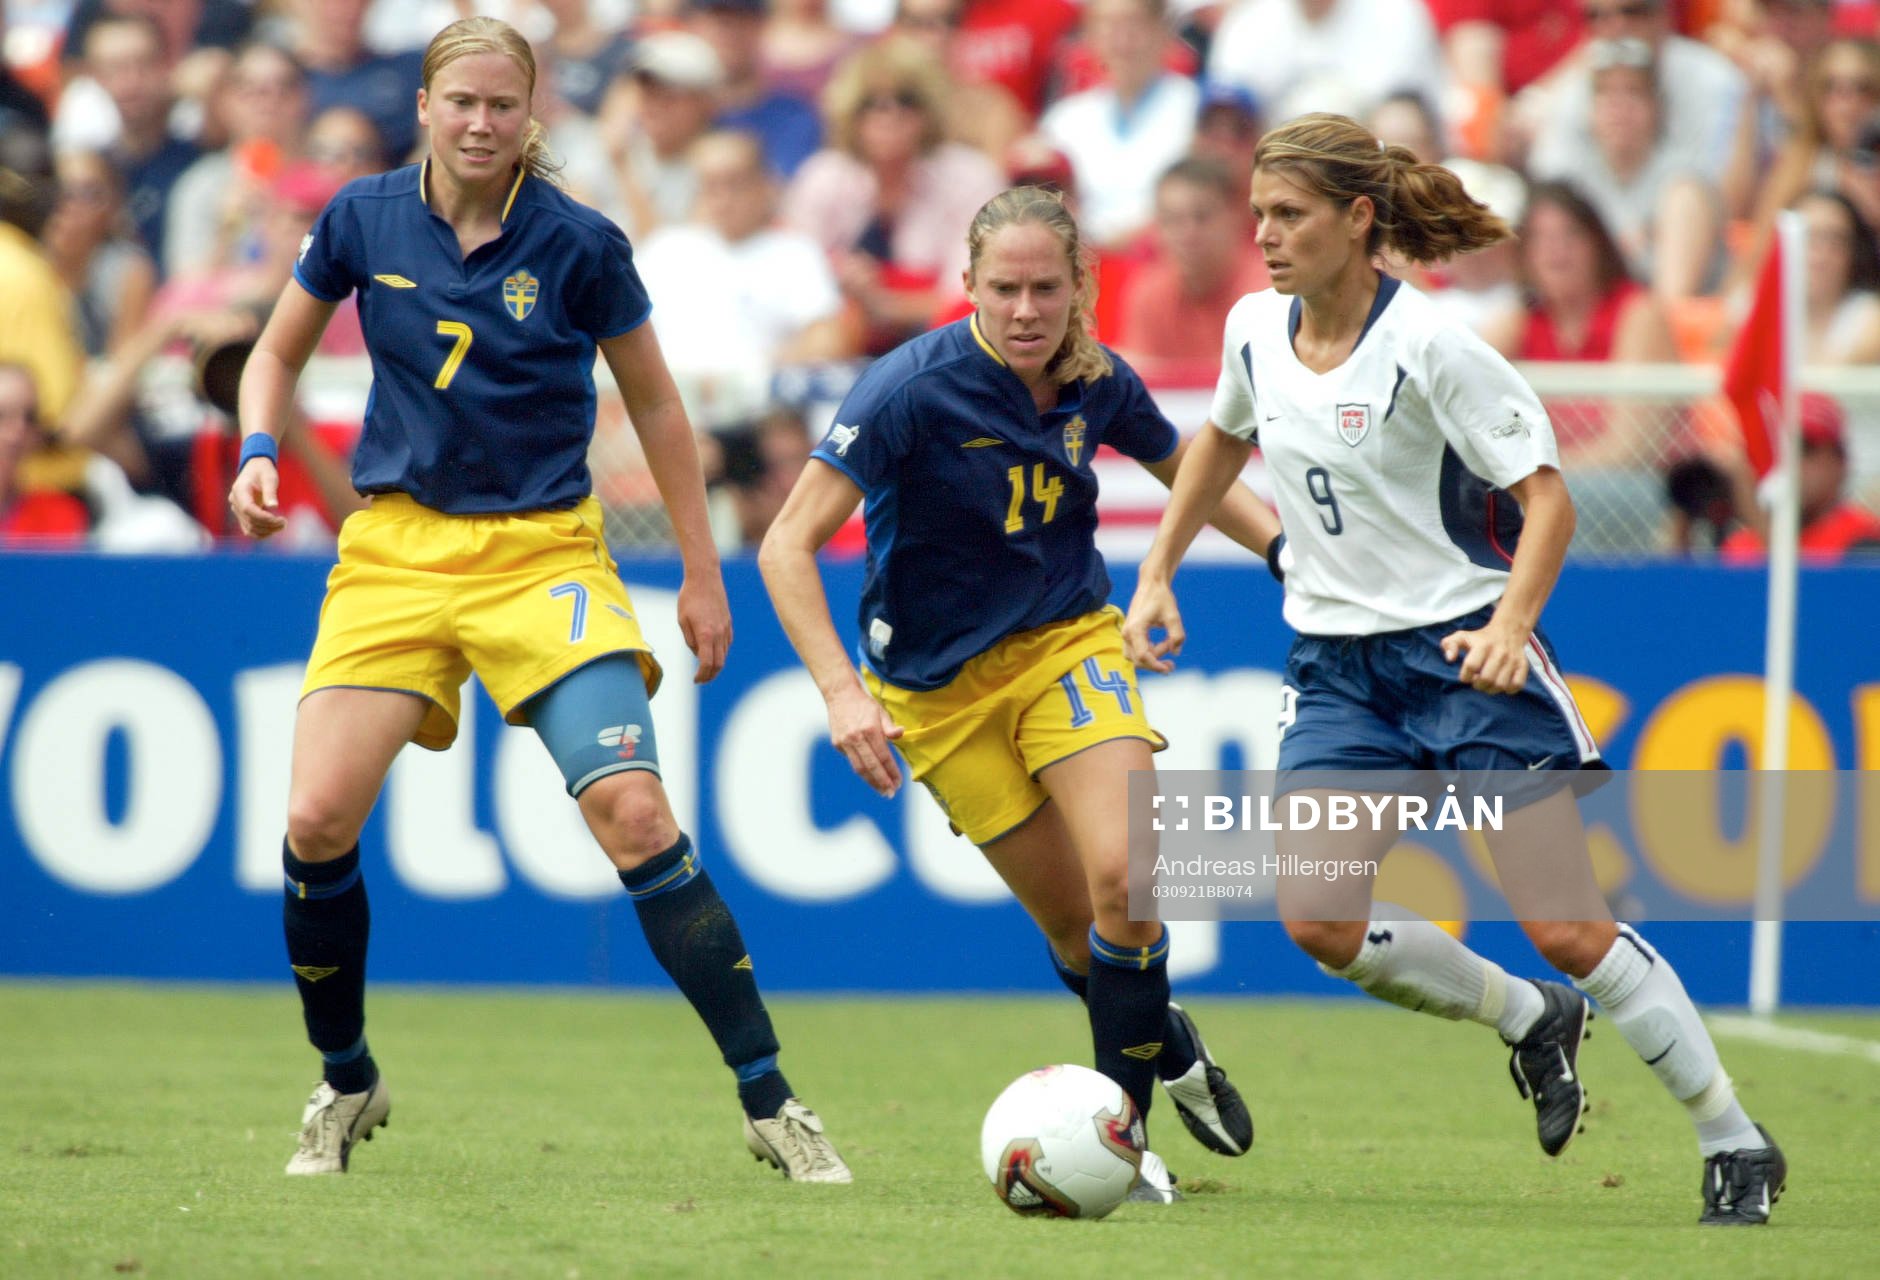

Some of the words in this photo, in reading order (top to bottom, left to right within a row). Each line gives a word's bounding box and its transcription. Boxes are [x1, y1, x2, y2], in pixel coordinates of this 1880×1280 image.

[434, 320, 474, 389] 7
[1004, 463, 1065, 534] 14
[1306, 467, 1344, 535] 9
[548, 582, 588, 643] 7
[1058, 656, 1133, 728] 14
